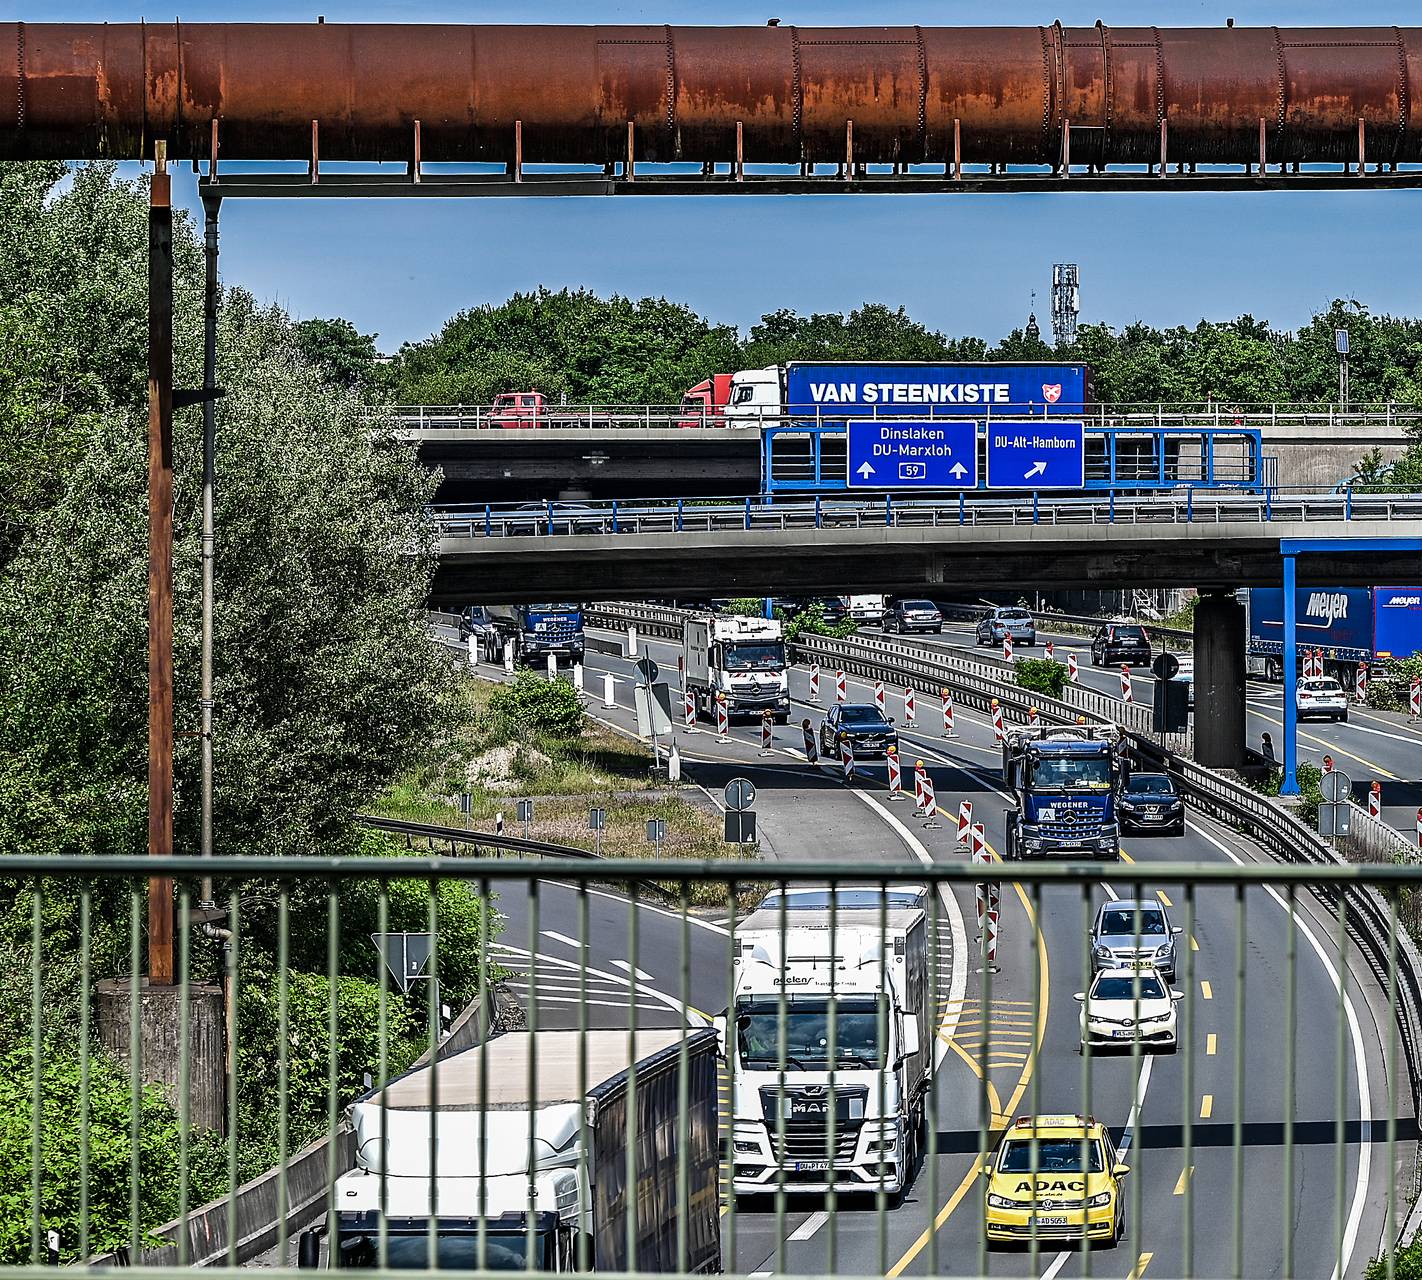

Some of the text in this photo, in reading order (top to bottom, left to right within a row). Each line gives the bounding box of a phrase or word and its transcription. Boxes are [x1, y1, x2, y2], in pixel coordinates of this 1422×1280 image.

[810, 384, 1009, 402] VAN STEENKISTE
[881, 427, 944, 440] Dinslaken
[995, 435, 1076, 449] DU-Alt-Hamborn
[873, 443, 952, 456] DU-Marxloh
[905, 465, 919, 476] 59
[1050, 801, 1088, 809] WEGENER
[1042, 810, 1052, 820] A
[1014, 1181, 1084, 1193] ADAC
